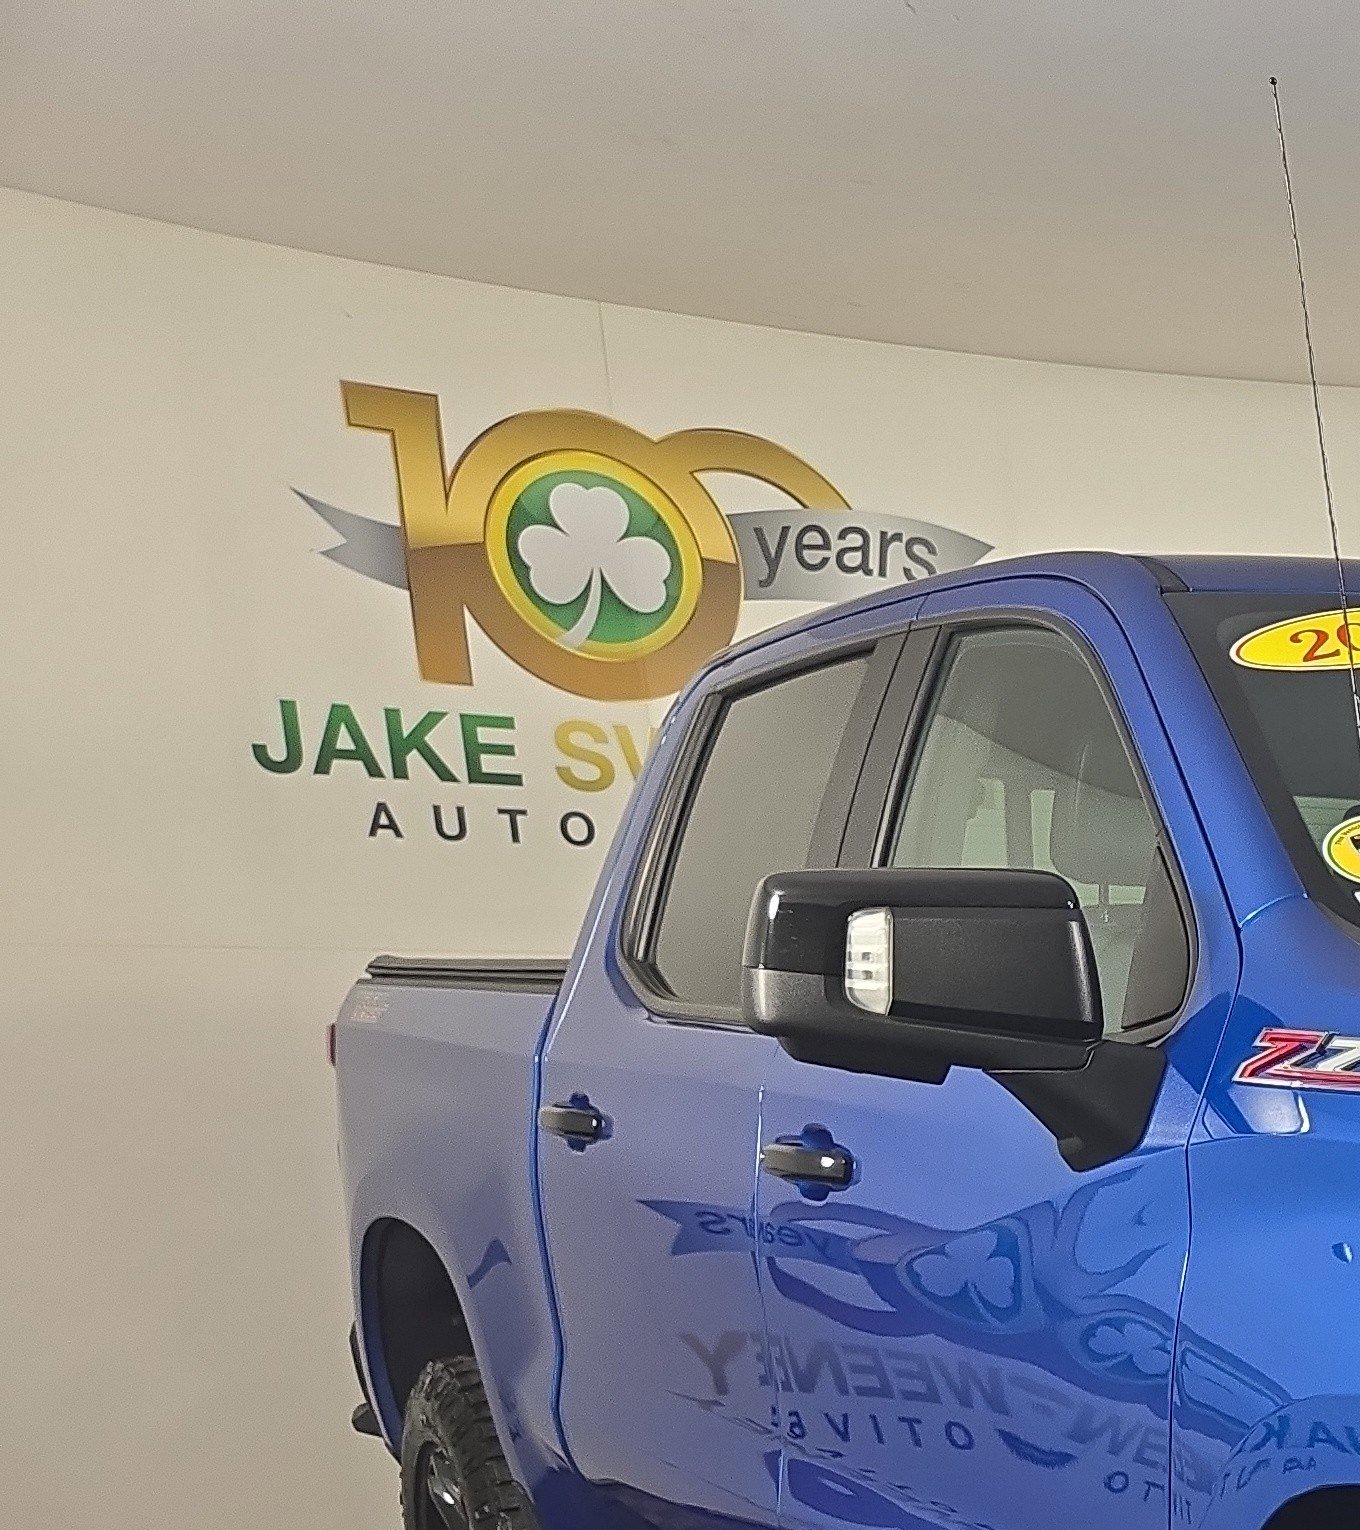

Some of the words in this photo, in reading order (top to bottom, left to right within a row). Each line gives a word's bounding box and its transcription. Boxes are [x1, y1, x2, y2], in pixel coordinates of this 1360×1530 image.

[754, 523, 938, 586] years
[251, 699, 523, 787] JAKE
[367, 801, 595, 847] AUTO
